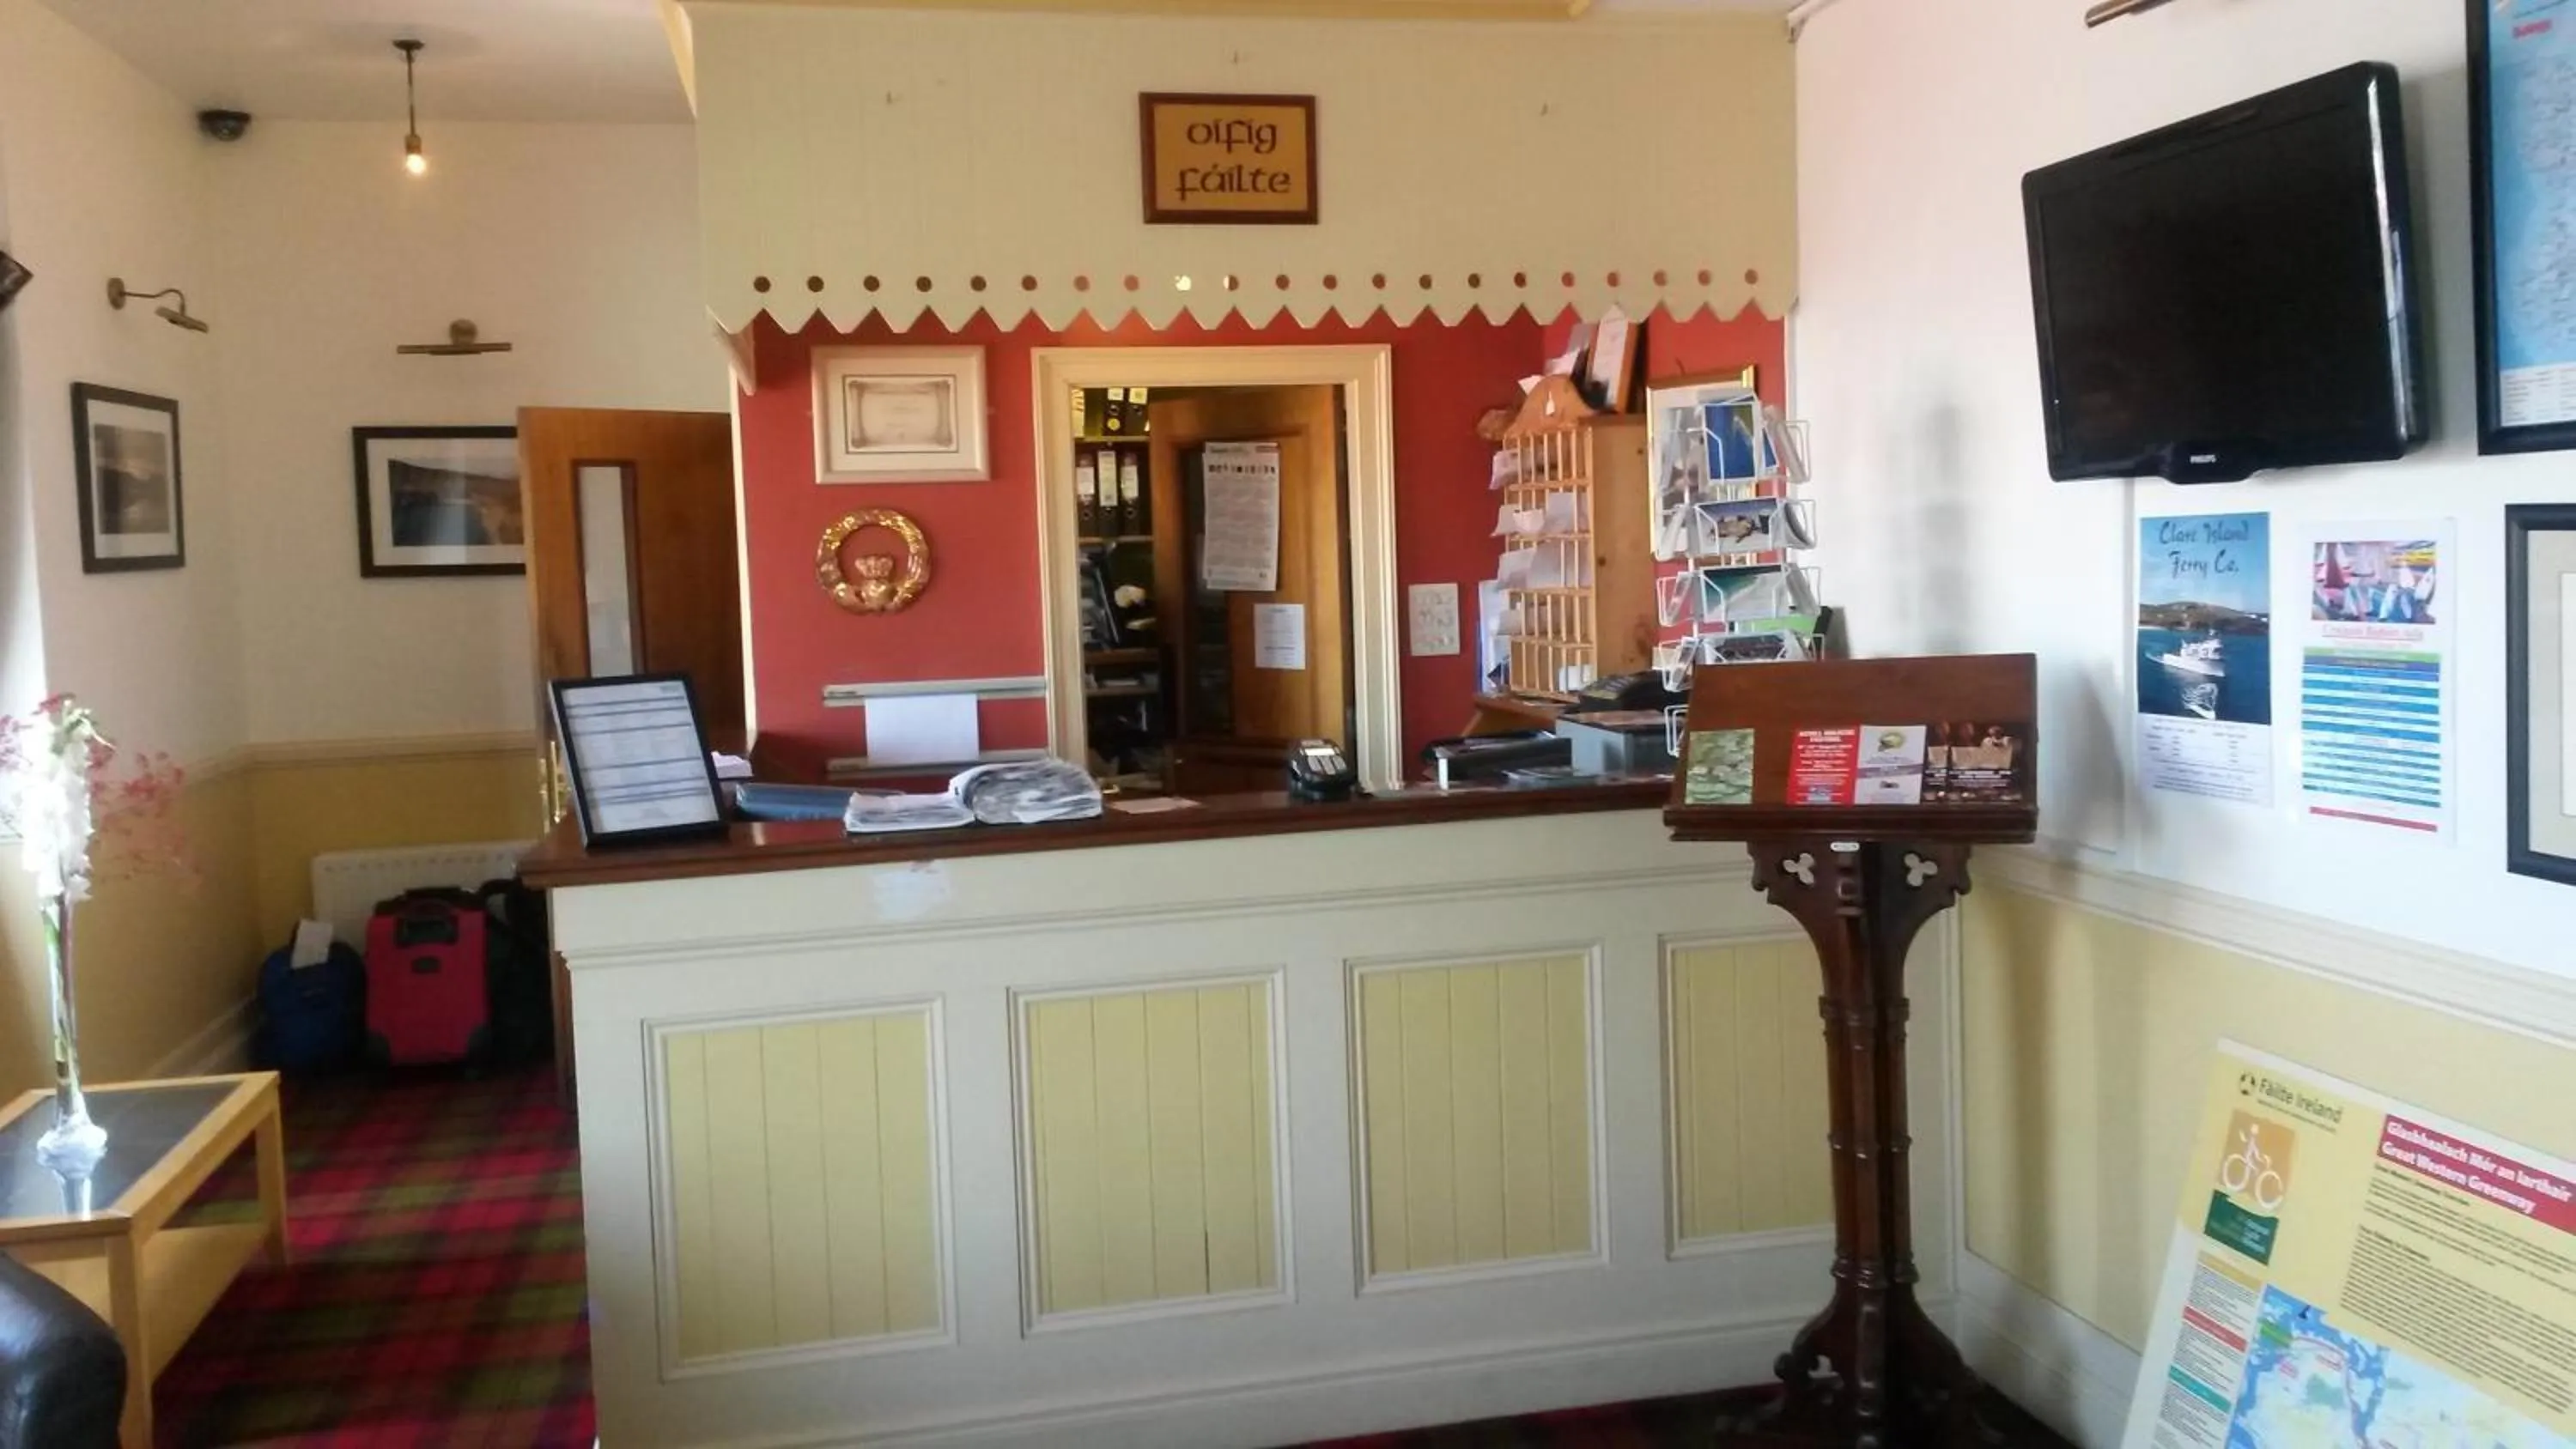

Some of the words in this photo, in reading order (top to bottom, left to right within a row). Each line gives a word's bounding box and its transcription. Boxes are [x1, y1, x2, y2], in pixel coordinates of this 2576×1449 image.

[2159, 520, 2197, 544] Clare
[2202, 518, 2249, 544] Island
[2168, 549, 2207, 579] Ferry
[2295, 1092, 2344, 1125] Ireland
[2381, 1140, 2416, 1165] Great
[2416, 1154, 2467, 1185] Western
